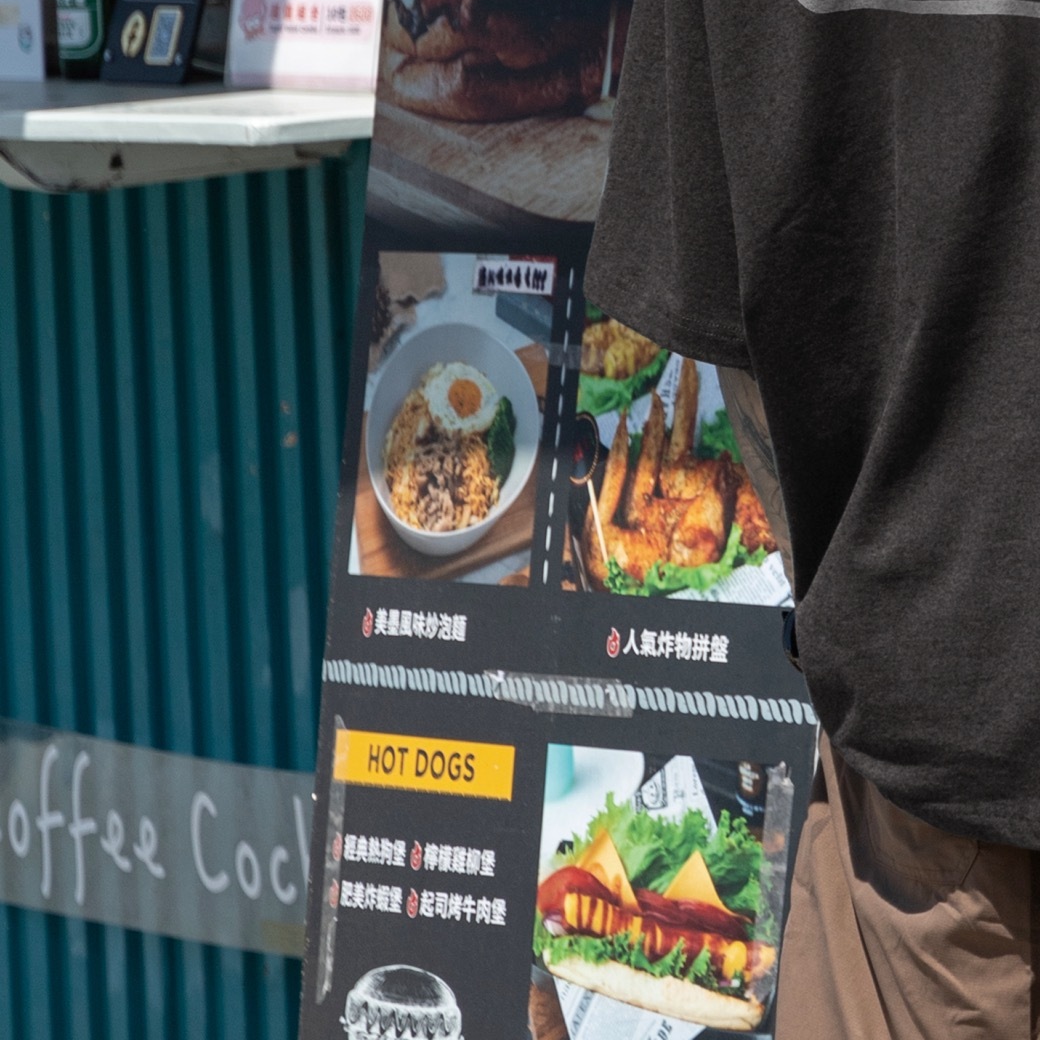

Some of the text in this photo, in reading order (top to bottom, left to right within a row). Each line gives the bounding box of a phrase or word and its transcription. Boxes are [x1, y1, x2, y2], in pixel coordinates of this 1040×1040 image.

[622, 627, 730, 663] 人氣炸物拼盤
[367, 743, 476, 782] HOT DOGS
[0, 744, 166, 906] offee
[419, 888, 507, 927] 起司烤牛肉堡
